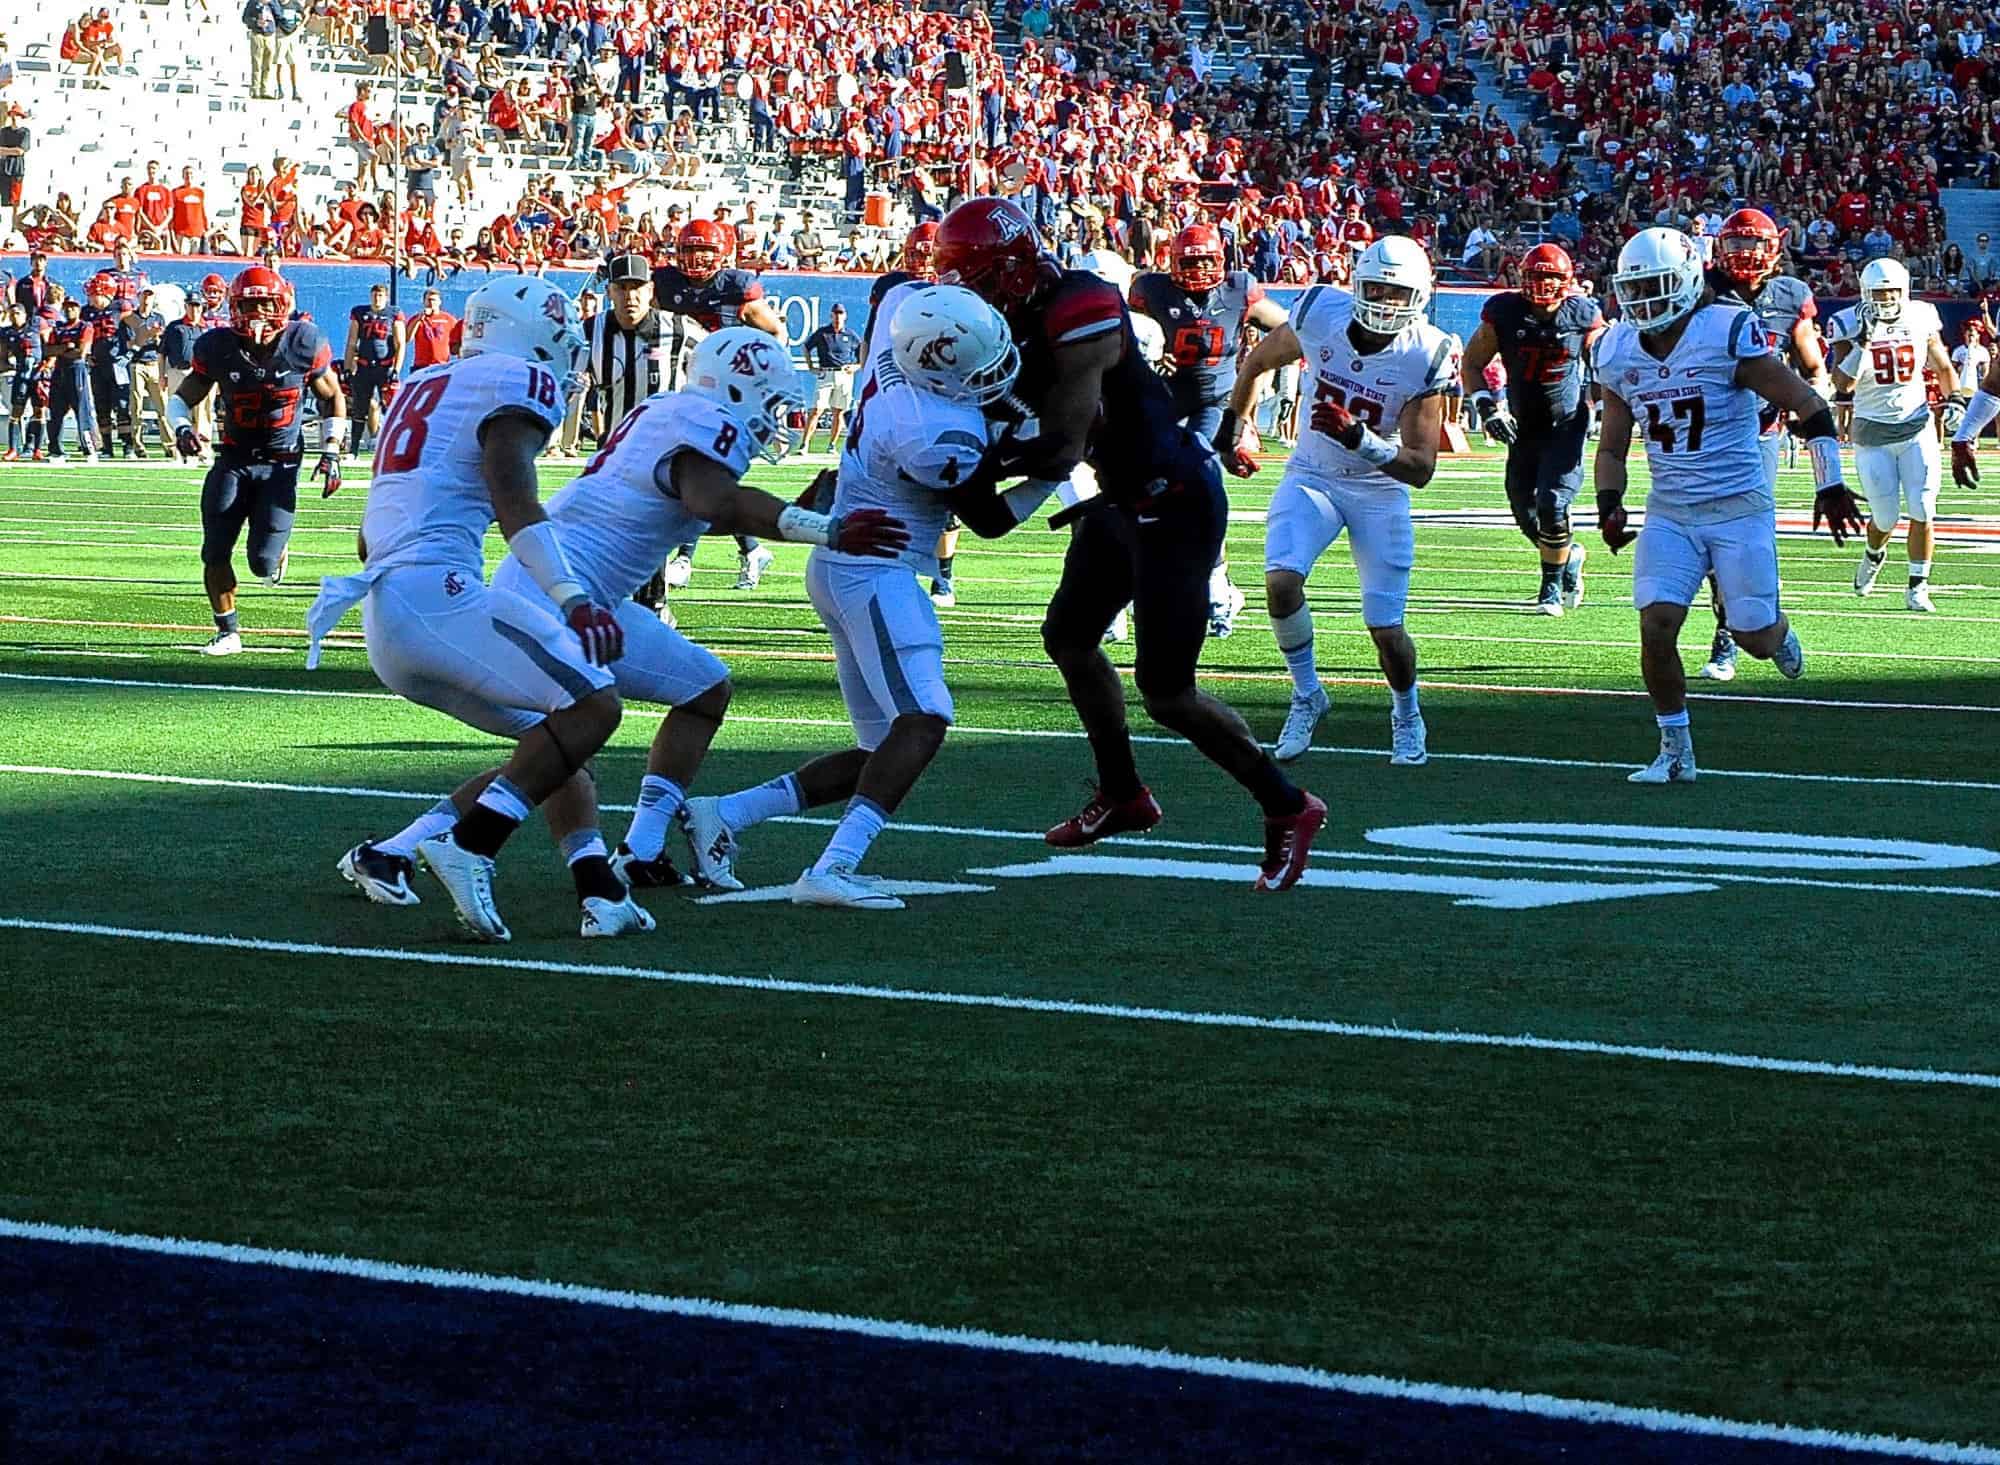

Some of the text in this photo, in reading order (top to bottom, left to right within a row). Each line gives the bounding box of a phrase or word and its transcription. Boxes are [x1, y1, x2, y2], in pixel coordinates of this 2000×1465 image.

[987, 207, 1028, 245] A
[1174, 326, 1225, 366] 61
[1871, 344, 1915, 385] 99
[232, 386, 300, 428] 23
[527, 365, 557, 410] 18
[373, 373, 452, 475] 18
[714, 421, 739, 458] 8
[1644, 397, 1705, 454] 47
[938, 455, 959, 487] 4
